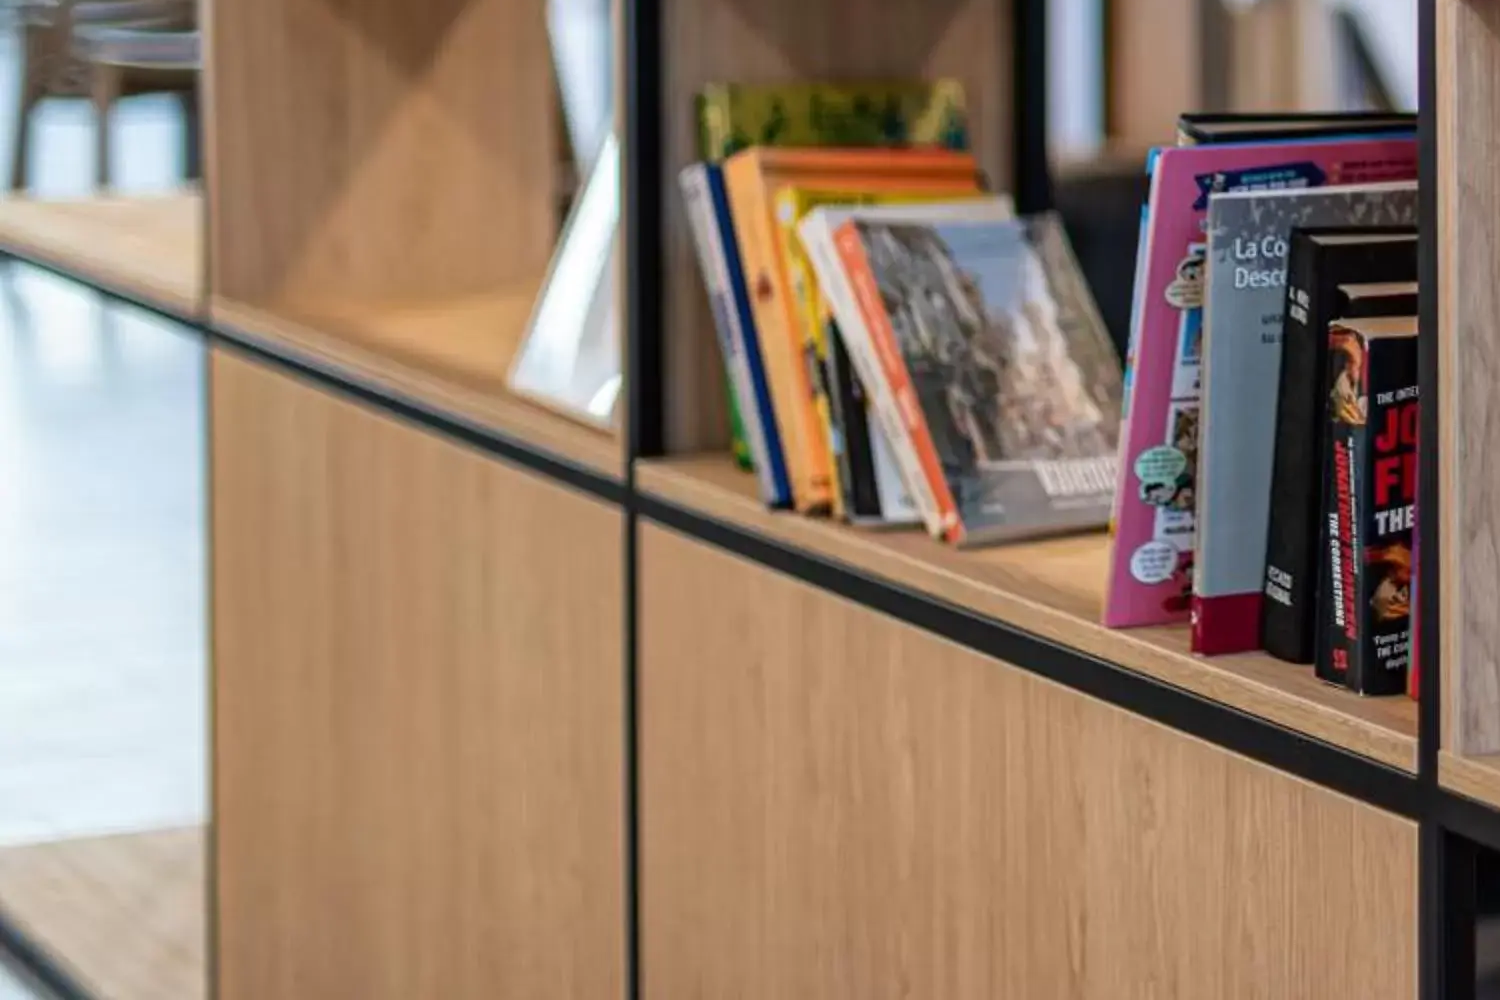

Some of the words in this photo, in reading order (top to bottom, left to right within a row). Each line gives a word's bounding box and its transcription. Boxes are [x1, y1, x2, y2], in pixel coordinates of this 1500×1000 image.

[1235, 236, 1258, 260] La
[1333, 440, 1351, 543] JONATHAN
[1375, 504, 1416, 536] THE
[1328, 512, 1339, 537] THE
[1329, 539, 1345, 627] CORRECTIONS
[1339, 545, 1359, 641] FRANZEN
